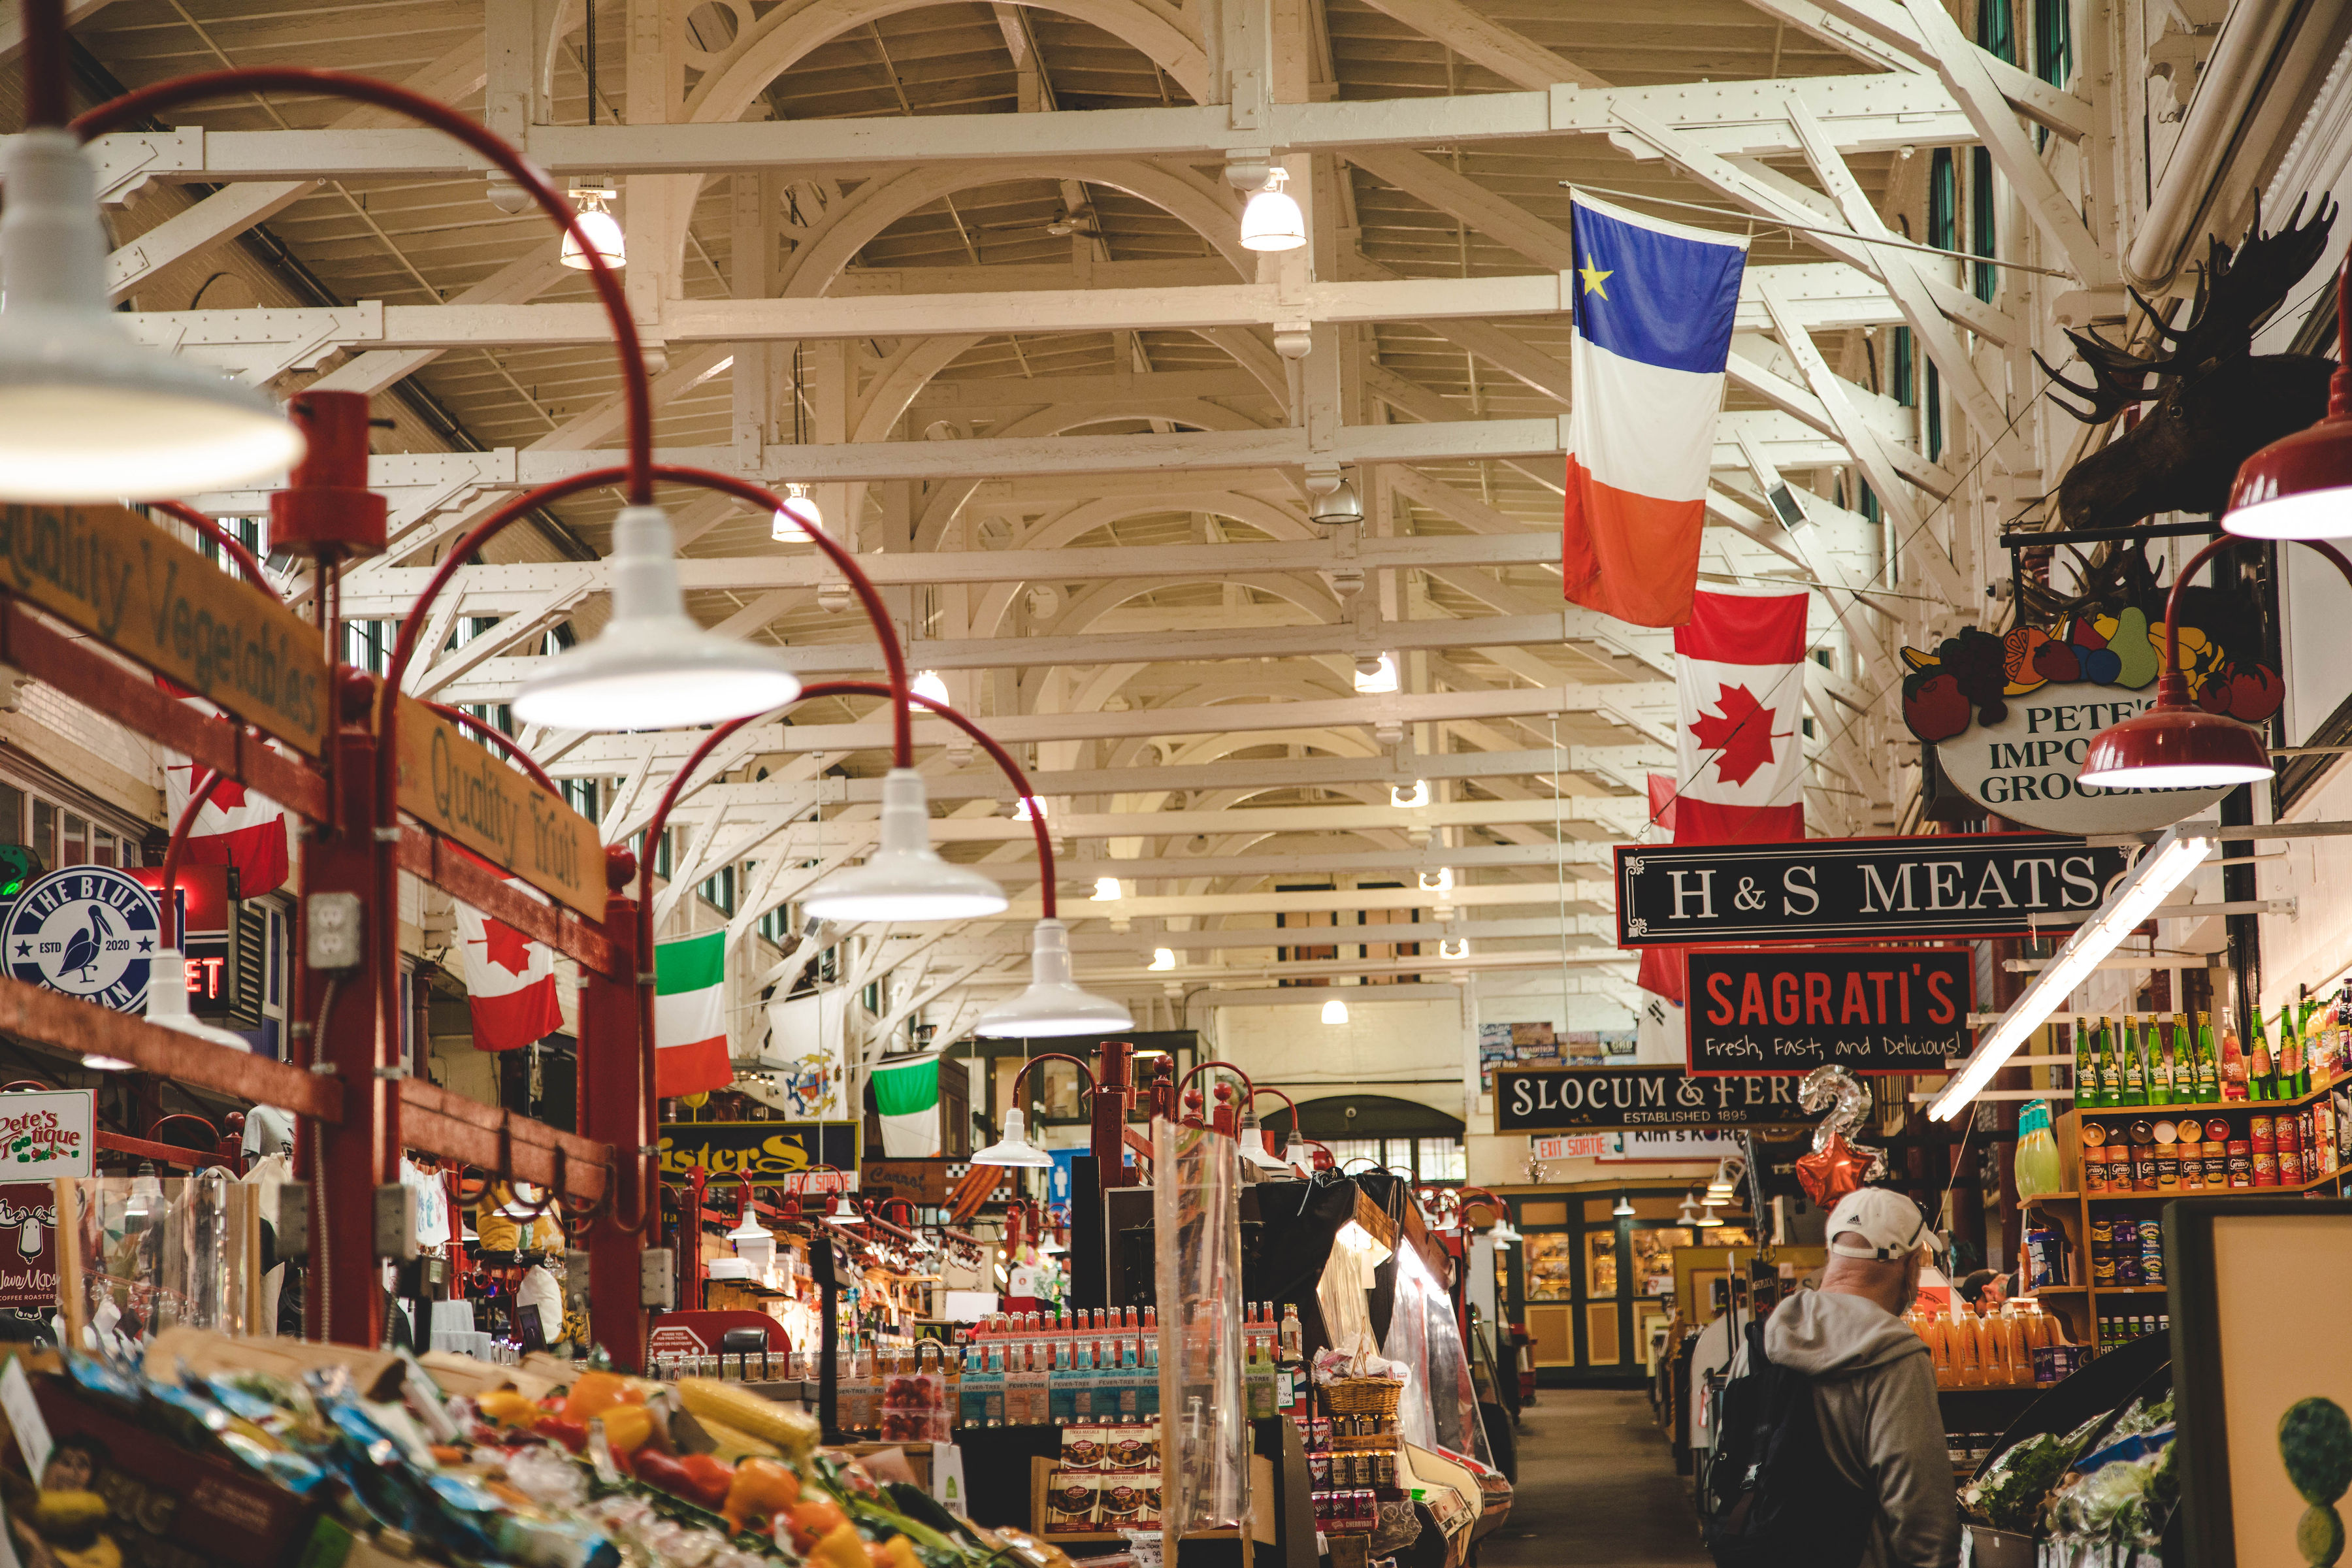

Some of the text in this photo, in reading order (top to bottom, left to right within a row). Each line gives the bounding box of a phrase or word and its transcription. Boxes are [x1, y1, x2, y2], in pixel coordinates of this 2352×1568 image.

[140, 537, 319, 736] Vegetables
[431, 725, 580, 890] Quality Fruit
[24, 876, 143, 921] THE BLUE
[1667, 857, 2099, 919] H & S MEATS
[39, 942, 61, 953] ESTD
[105, 939, 129, 951] 2020
[1707, 963, 1956, 1026] SAGRATI'S
[1705, 1031, 1961, 1061] Fresh, Fast, and Delicious!
[1512, 1076, 1803, 1115] SLOCUM & FER
[1624, 1111, 1747, 1123] ESTABLISHED 1895
[659, 1134, 830, 1176] isterS
[1540, 1137, 1607, 1158] EXIT SORTIE
